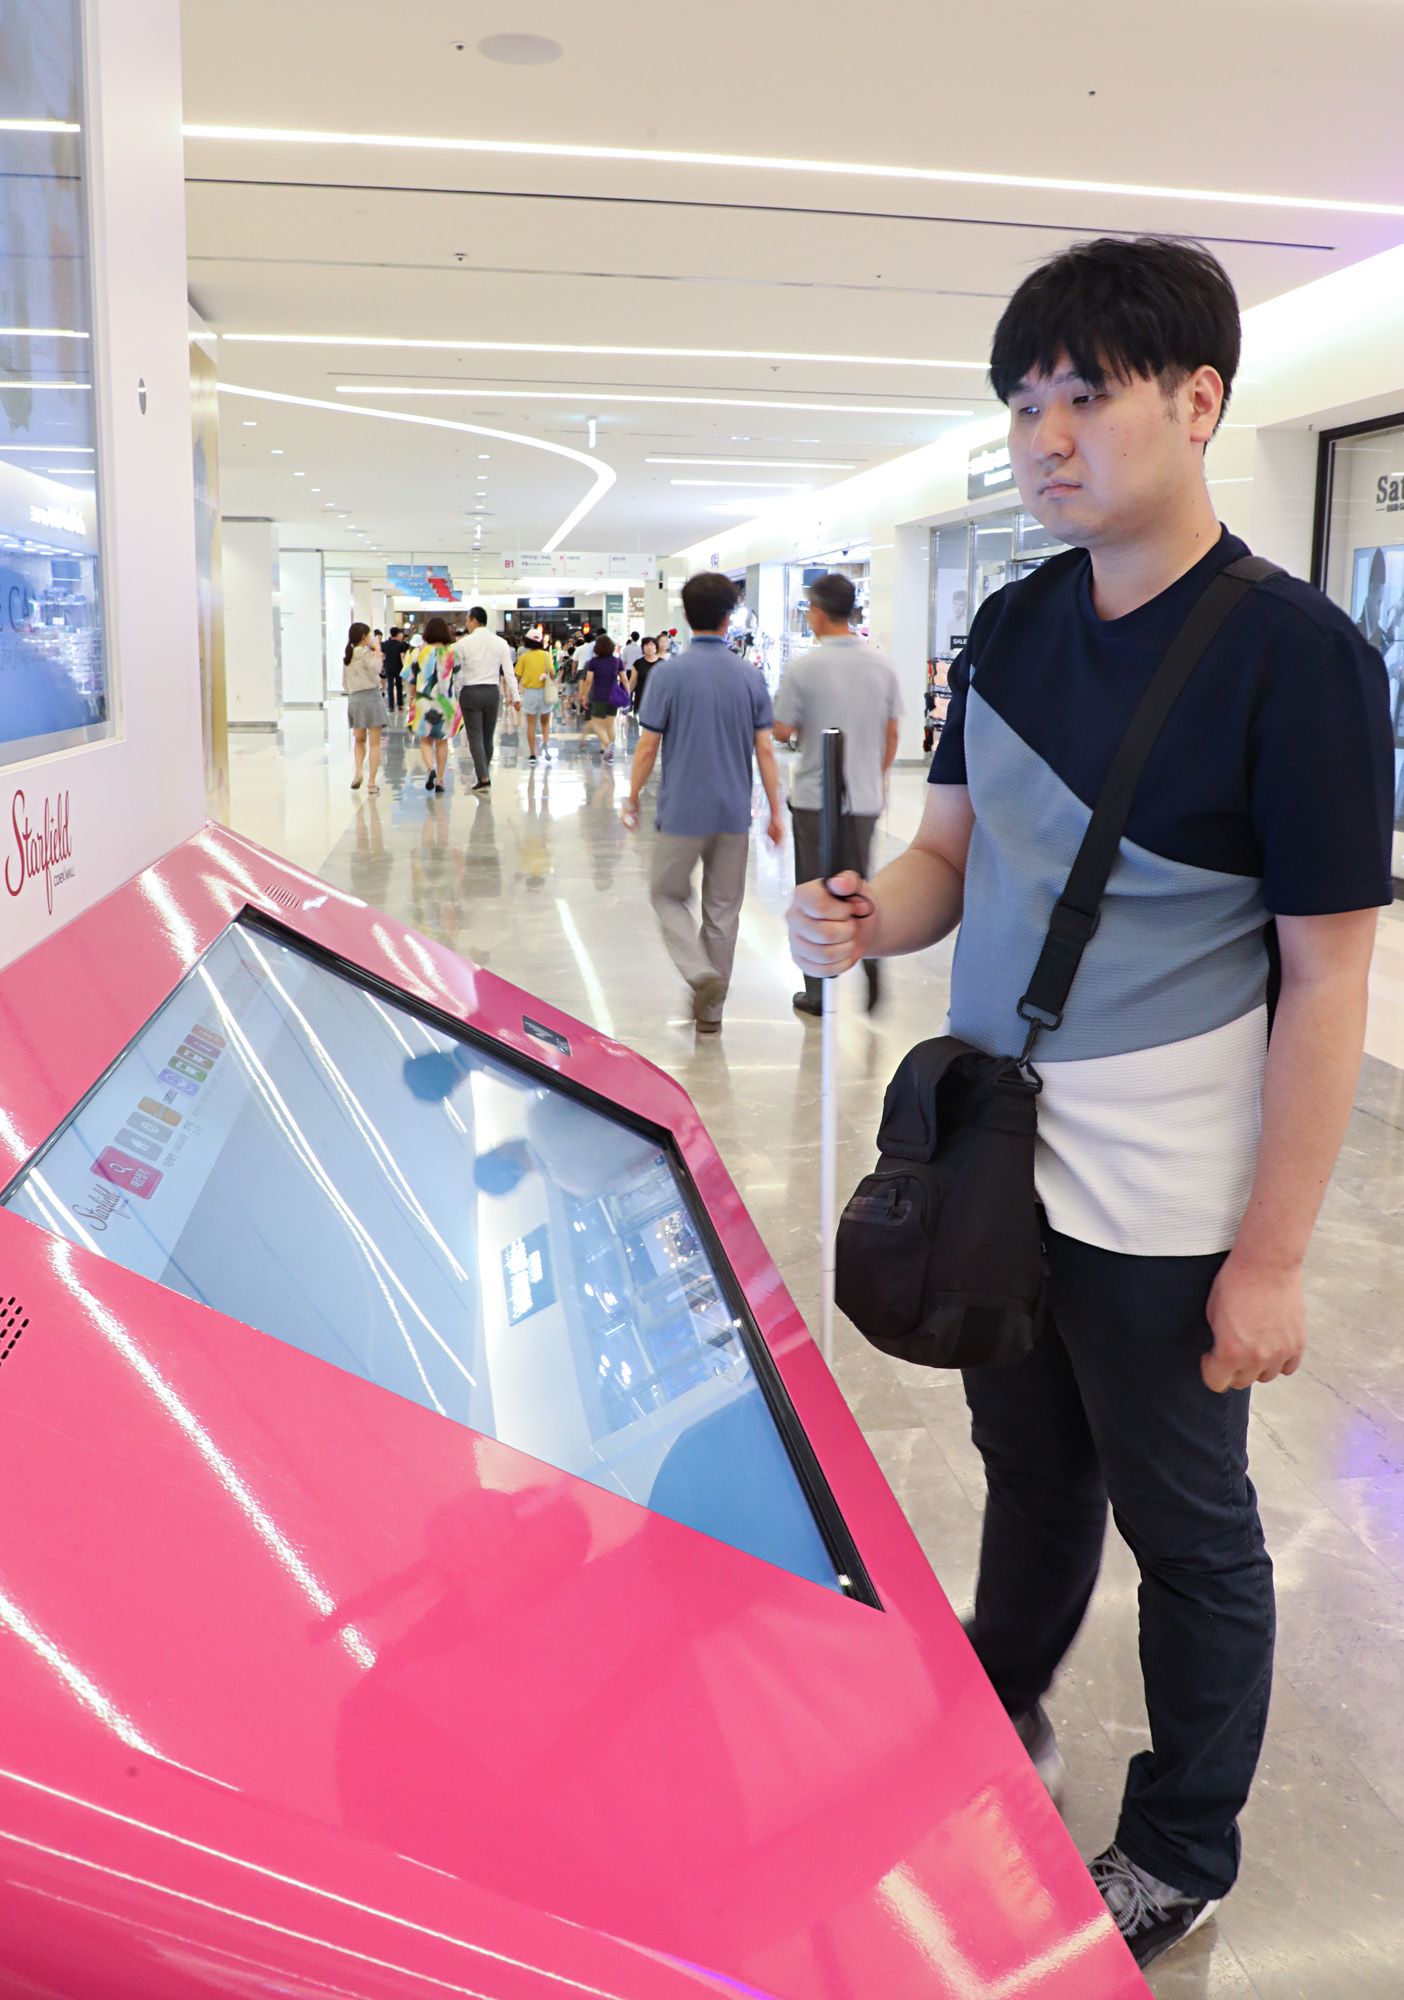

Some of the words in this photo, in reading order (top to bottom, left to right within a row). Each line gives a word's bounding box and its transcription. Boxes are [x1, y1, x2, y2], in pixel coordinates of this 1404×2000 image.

[504, 560, 515, 568] B1
[5, 789, 72, 916] Starfield
[72, 1183, 131, 1232] Starfield
